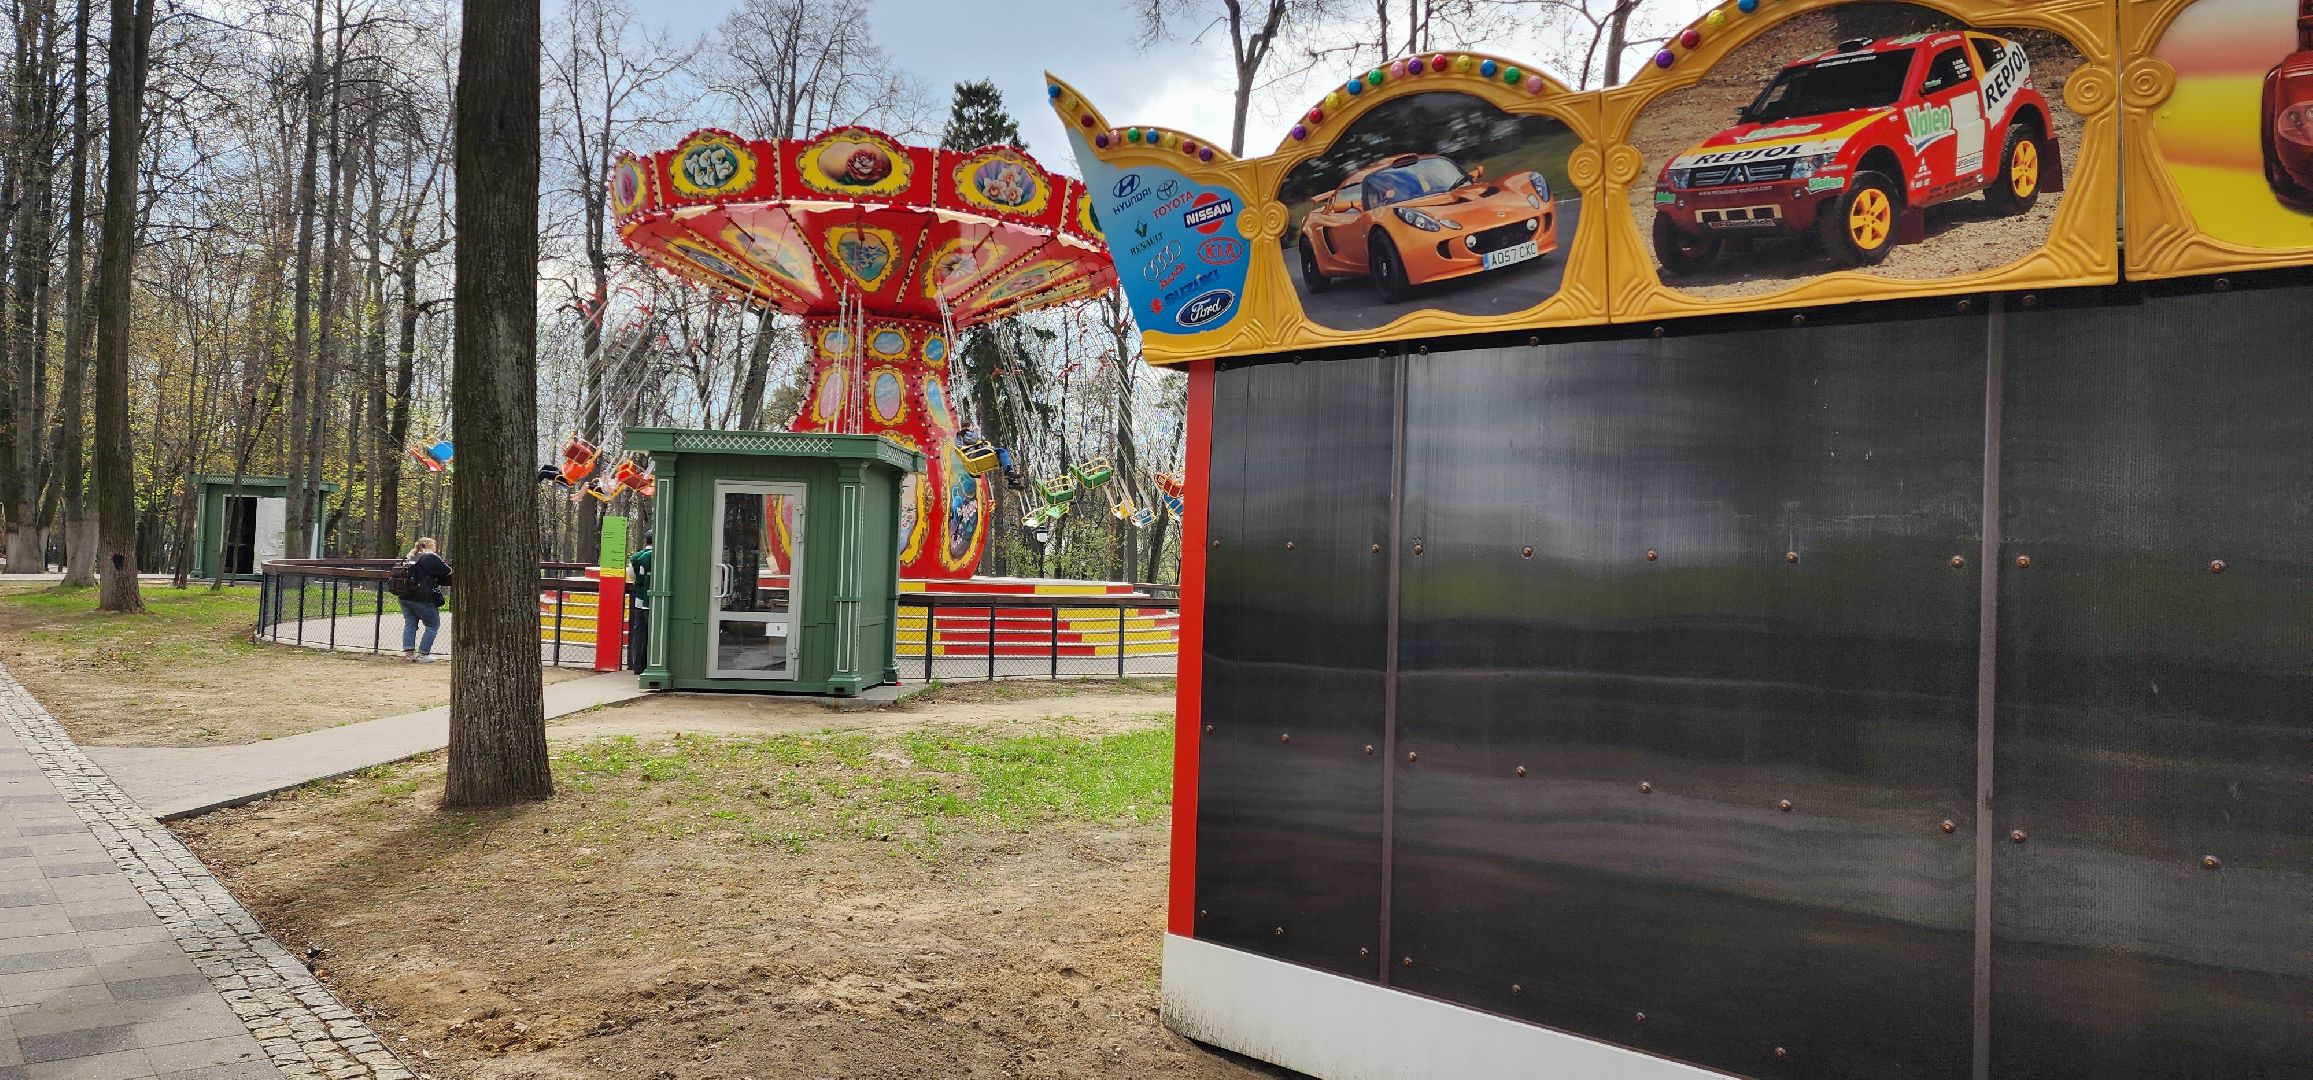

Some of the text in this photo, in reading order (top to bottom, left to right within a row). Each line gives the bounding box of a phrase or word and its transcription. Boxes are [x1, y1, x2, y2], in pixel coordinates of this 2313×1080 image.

[1985, 45, 2026, 111] REPSOL
[1904, 102, 1951, 138] Valeo
[1694, 144, 1804, 166] REPSOL
[1112, 187, 1152, 216] HYUNDAI
[1152, 191, 1195, 220] TOYOTA
[1185, 201, 1232, 227] NISSAN
[1130, 231, 1164, 256] RENAULT
[1205, 242, 1236, 259] KIA
[1519, 242, 1537, 258] CXC
[1190, 297, 1222, 322] Ford
